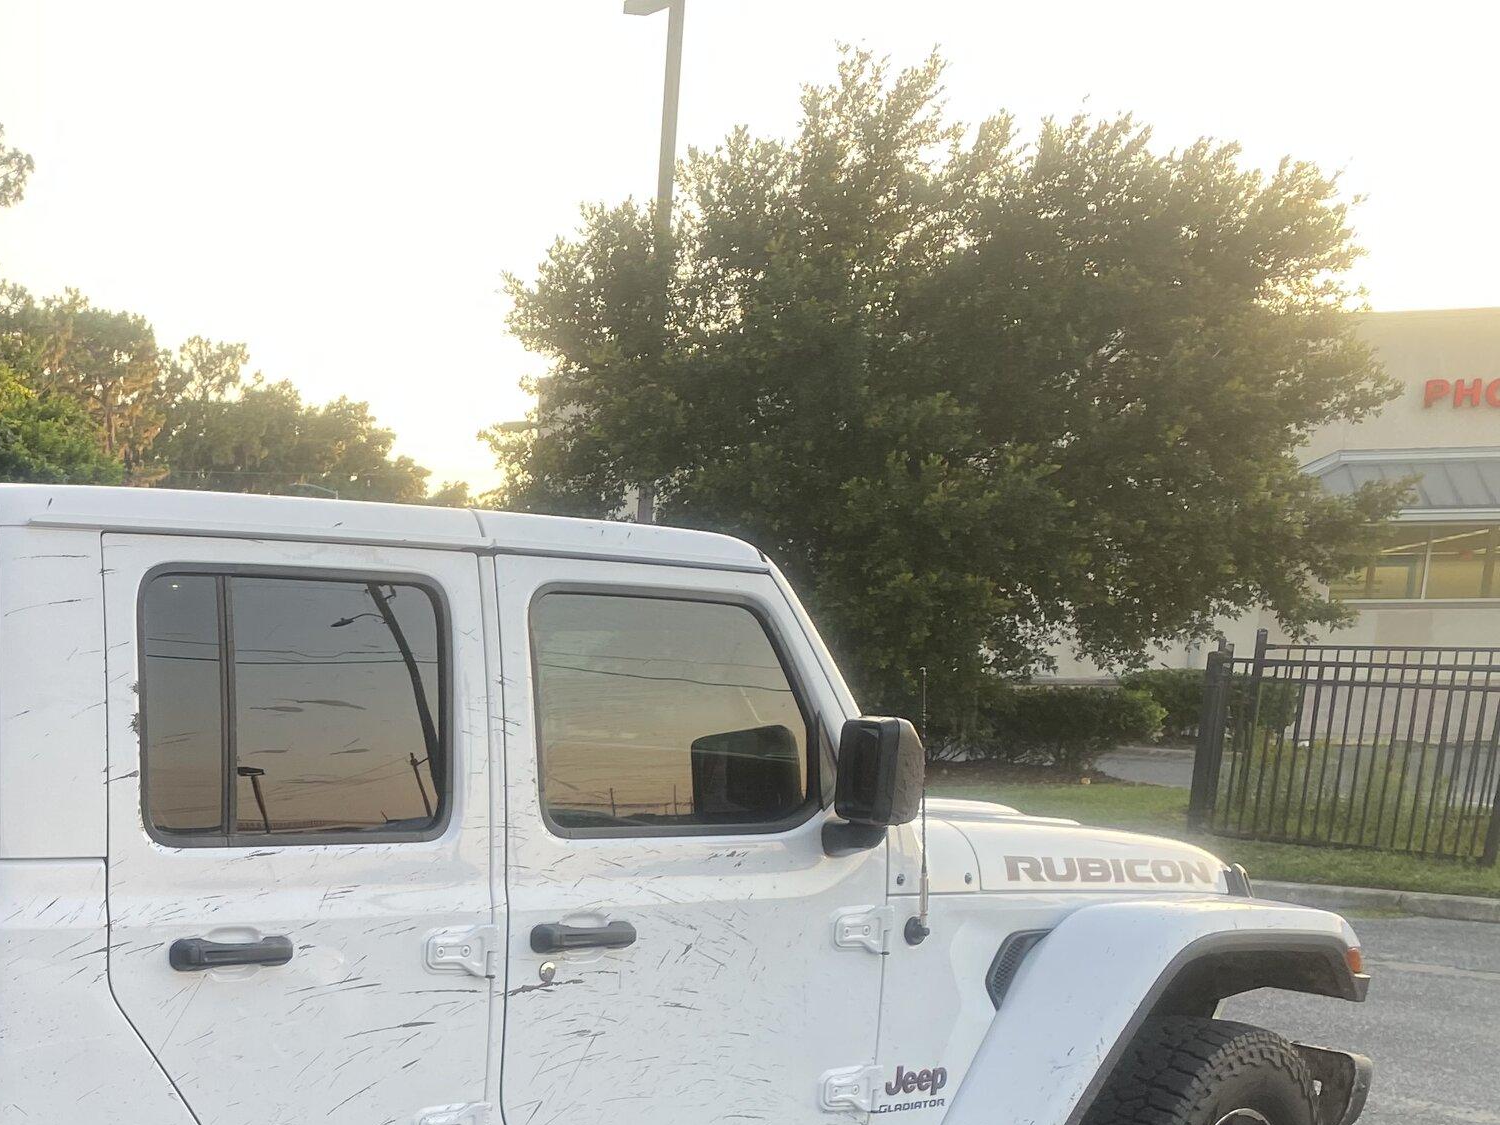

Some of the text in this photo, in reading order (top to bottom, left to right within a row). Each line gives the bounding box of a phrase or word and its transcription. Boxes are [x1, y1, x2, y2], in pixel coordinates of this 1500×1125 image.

[1003, 855, 1212, 884] RUBICON
[885, 1066, 947, 1096] Jeep
[879, 1098, 945, 1113] GLADIATOR
